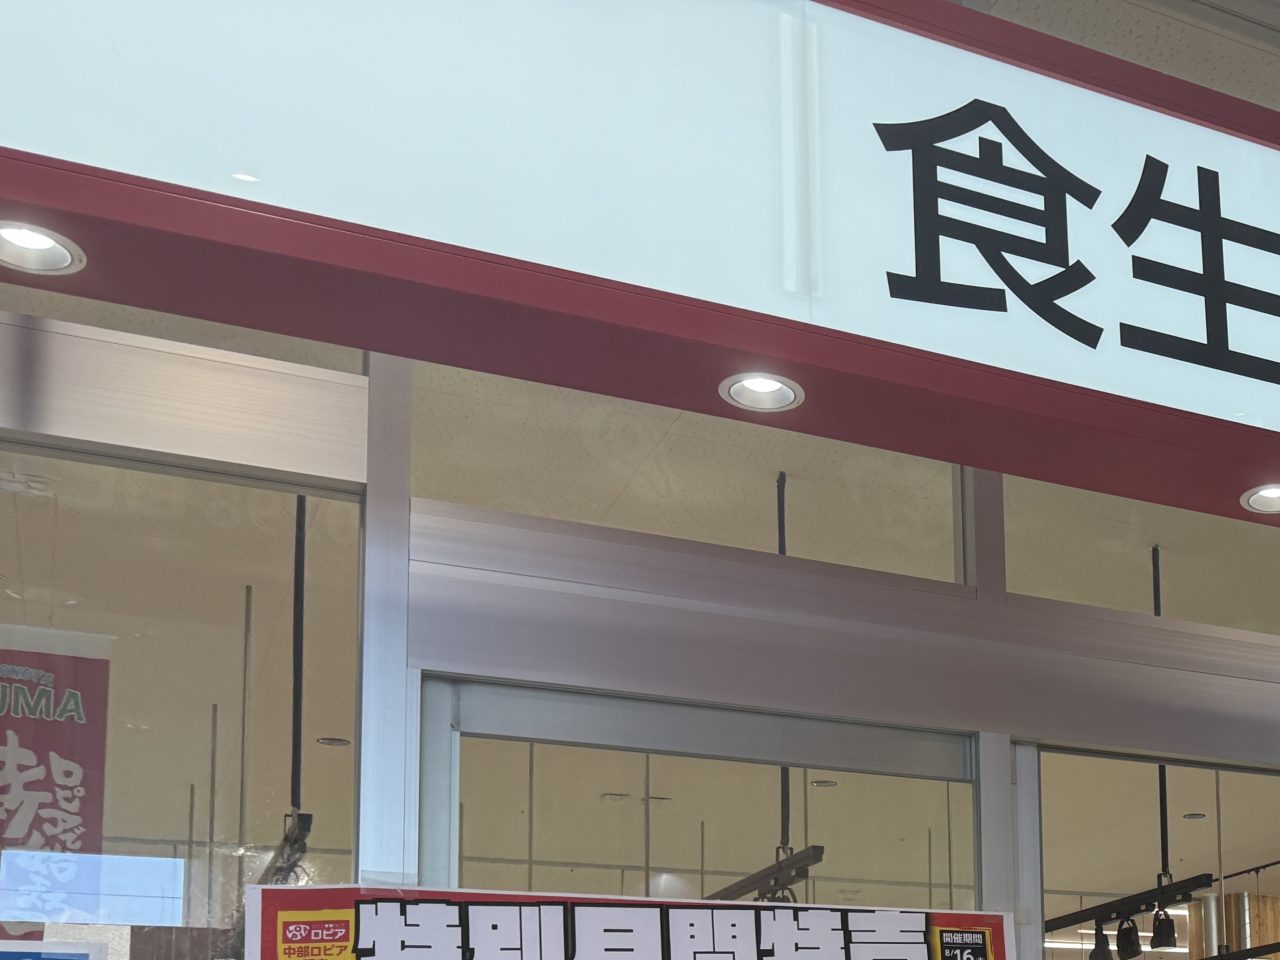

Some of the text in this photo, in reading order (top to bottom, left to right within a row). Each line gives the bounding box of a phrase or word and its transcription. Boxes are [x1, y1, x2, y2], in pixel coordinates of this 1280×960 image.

[311, 929, 346, 939] ロピア
[943, 933, 983, 943] 開催期間
[283, 944, 348, 958] 中部ロピア
